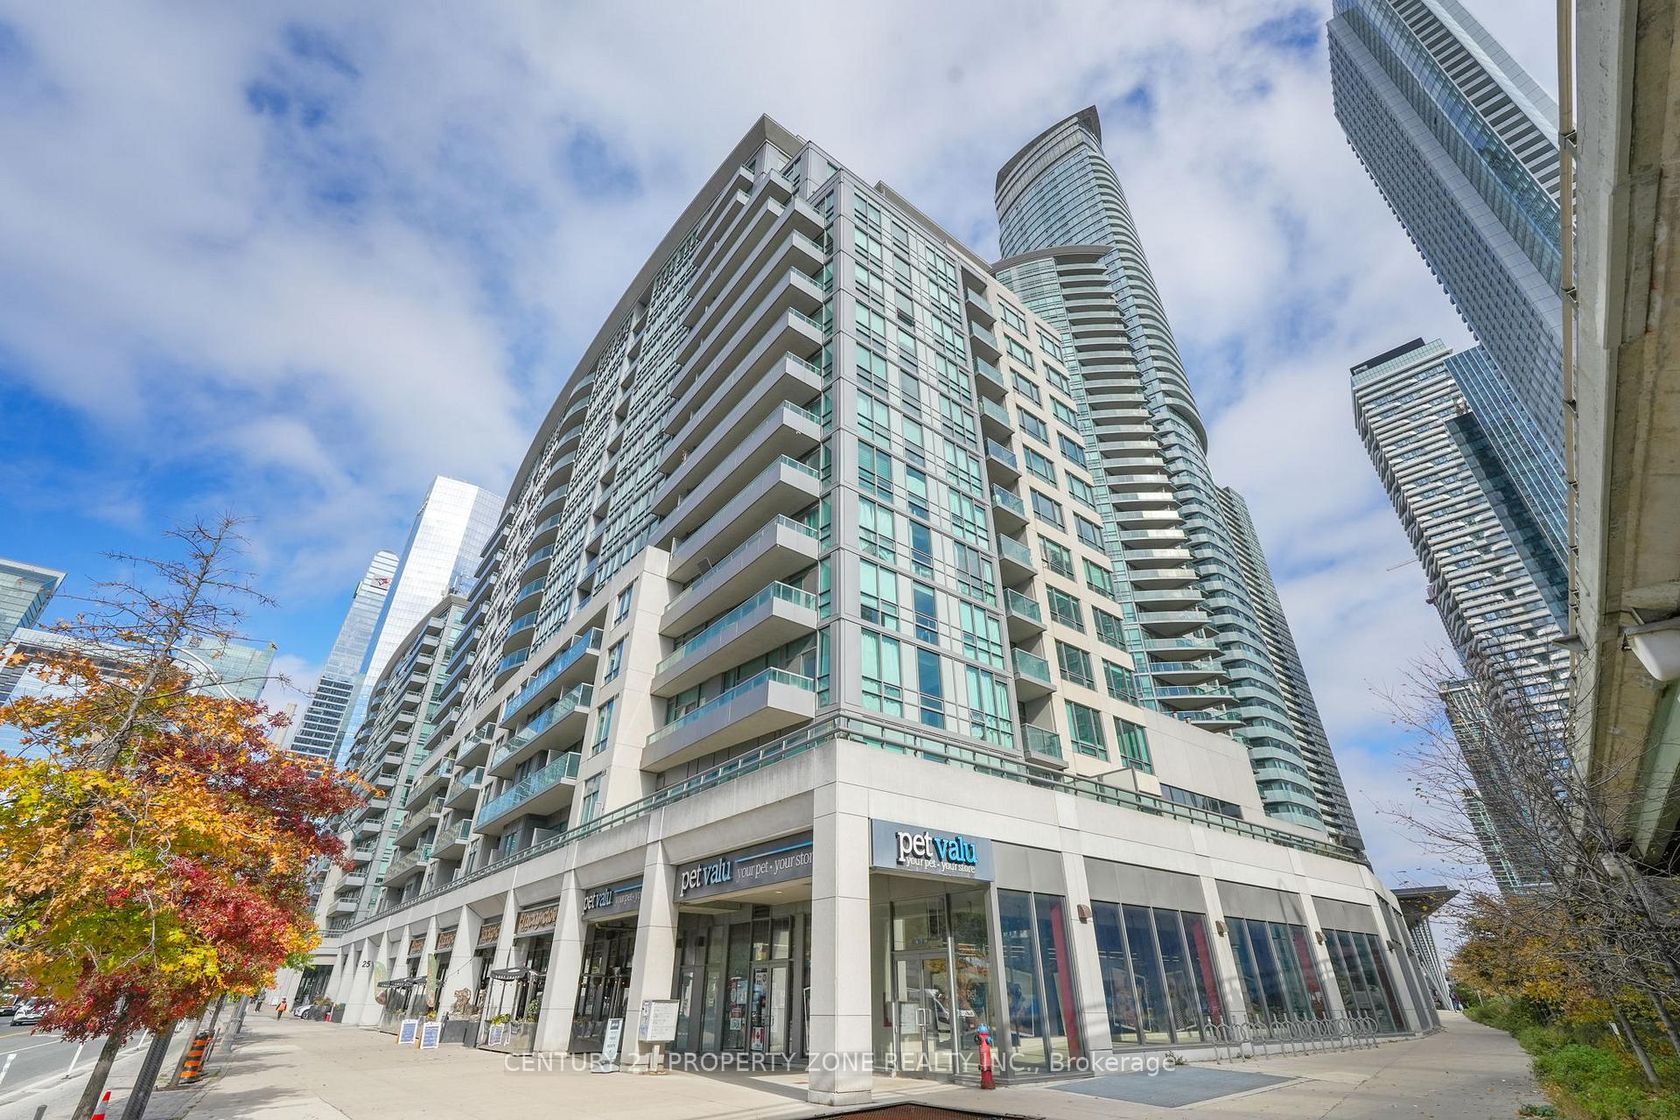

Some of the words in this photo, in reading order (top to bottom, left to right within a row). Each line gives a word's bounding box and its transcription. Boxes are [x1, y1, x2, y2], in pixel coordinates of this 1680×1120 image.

[896, 831, 933, 864] pet
[933, 836, 977, 865] valu
[680, 864, 701, 897] pet
[703, 858, 731, 886] valu
[755, 861, 769, 879] pet
[774, 855, 795, 875] your
[795, 851, 813, 867] stor
[905, 857, 923, 867] your
[942, 861, 957, 872] your
[958, 864, 976, 874] store
[361, 960, 371, 968] 25
